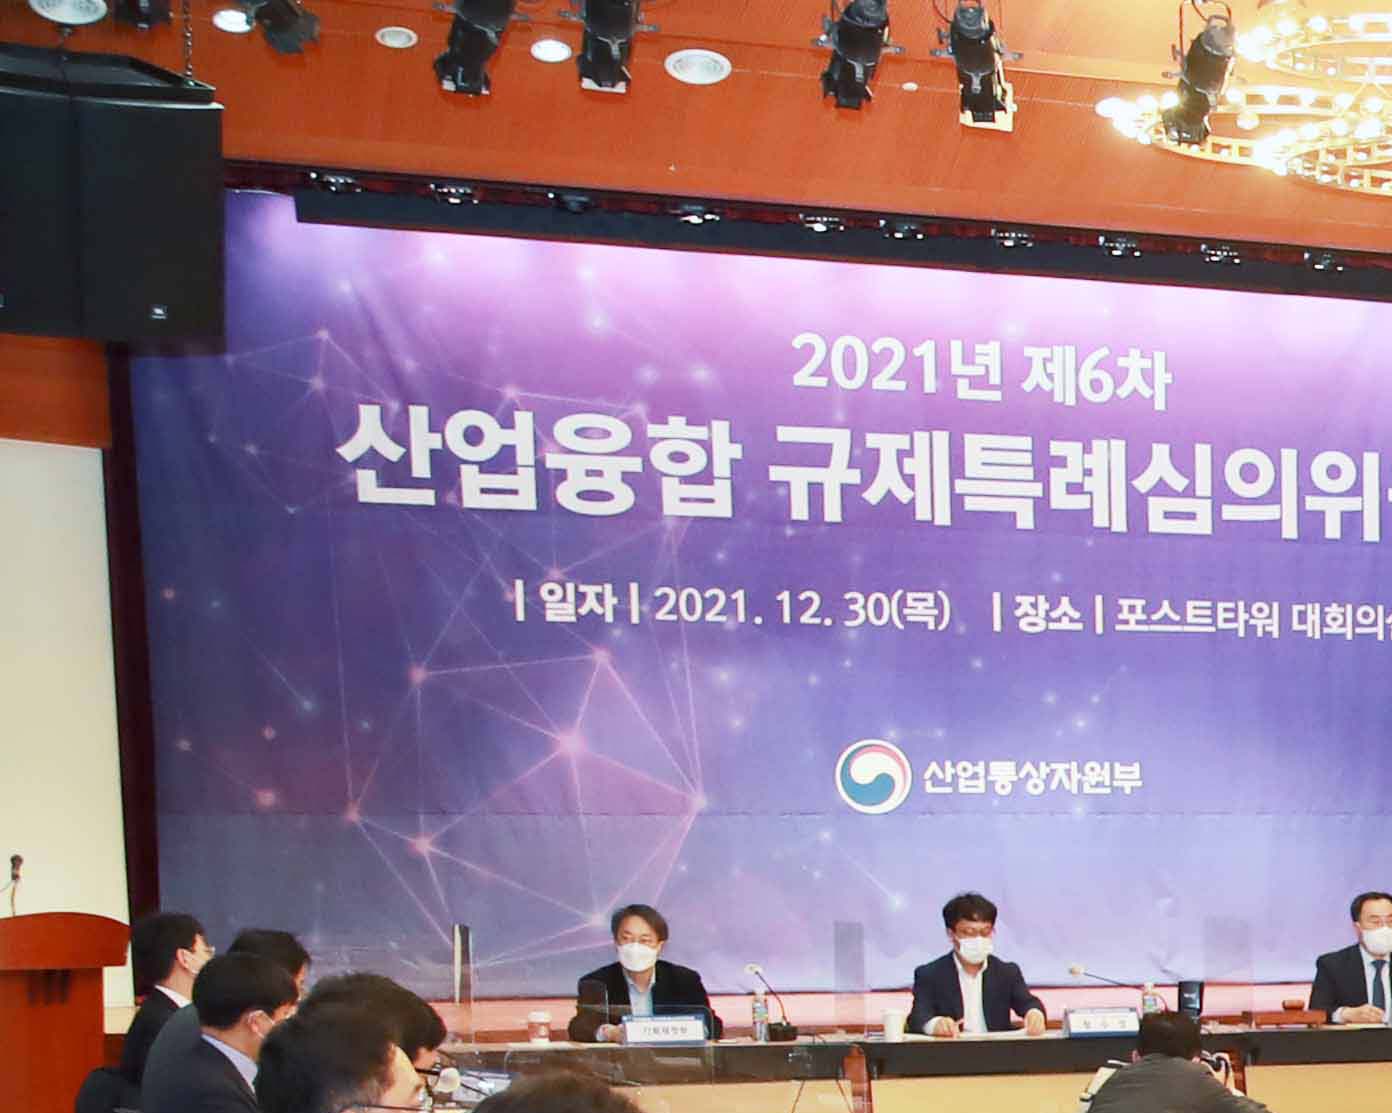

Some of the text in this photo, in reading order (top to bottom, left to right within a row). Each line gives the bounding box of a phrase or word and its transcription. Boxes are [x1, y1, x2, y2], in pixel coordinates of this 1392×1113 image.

[791, 333, 1173, 412] 2021년 제6차
[336, 404, 742, 519] 산업융합
[654, 586, 763, 625] 2021.
[776, 590, 833, 627] 12.
[843, 589, 951, 631] 30(목)
[1114, 598, 1281, 639] 포스트타워
[923, 760, 1143, 796] 산업통상자원부
